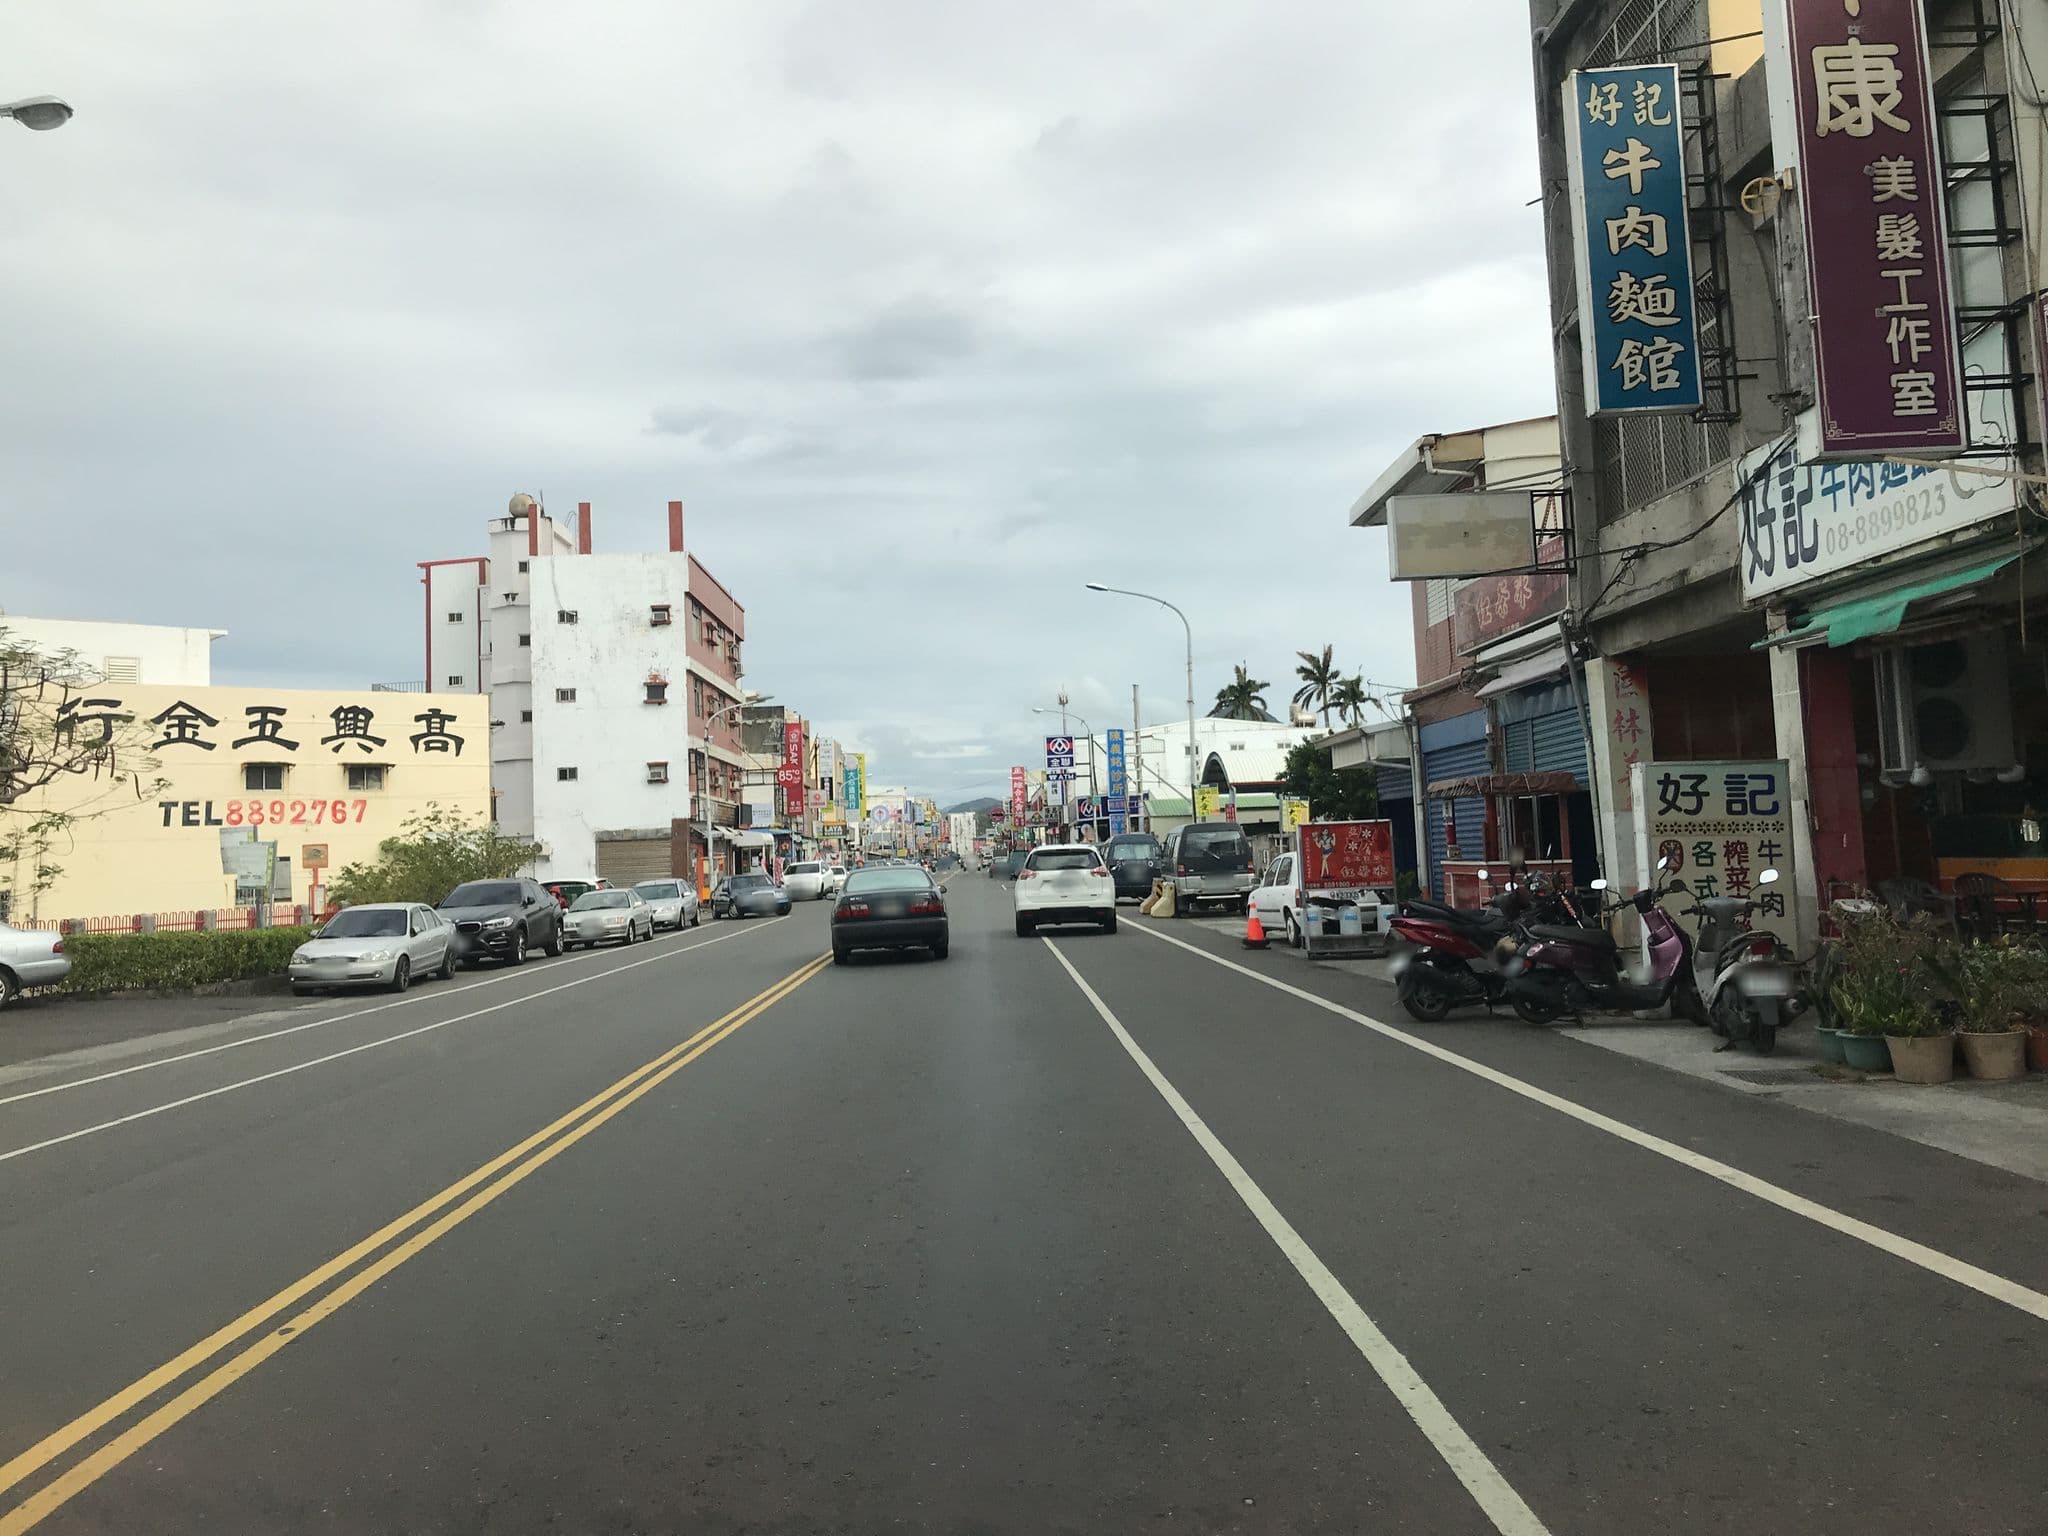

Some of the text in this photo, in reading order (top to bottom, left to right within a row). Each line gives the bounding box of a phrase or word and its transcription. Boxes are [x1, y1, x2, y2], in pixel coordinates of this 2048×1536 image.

[1585, 80, 1672, 127] 好記
[1811, 0, 1912, 138] 康
[1602, 137, 1686, 394] 牛肉麵館
[1871, 154, 1939, 418] 美髮工作室
[1743, 451, 1819, 584] 好記
[1825, 483, 1946, 556] 08-8899823
[1656, 772, 1779, 816] 好記
